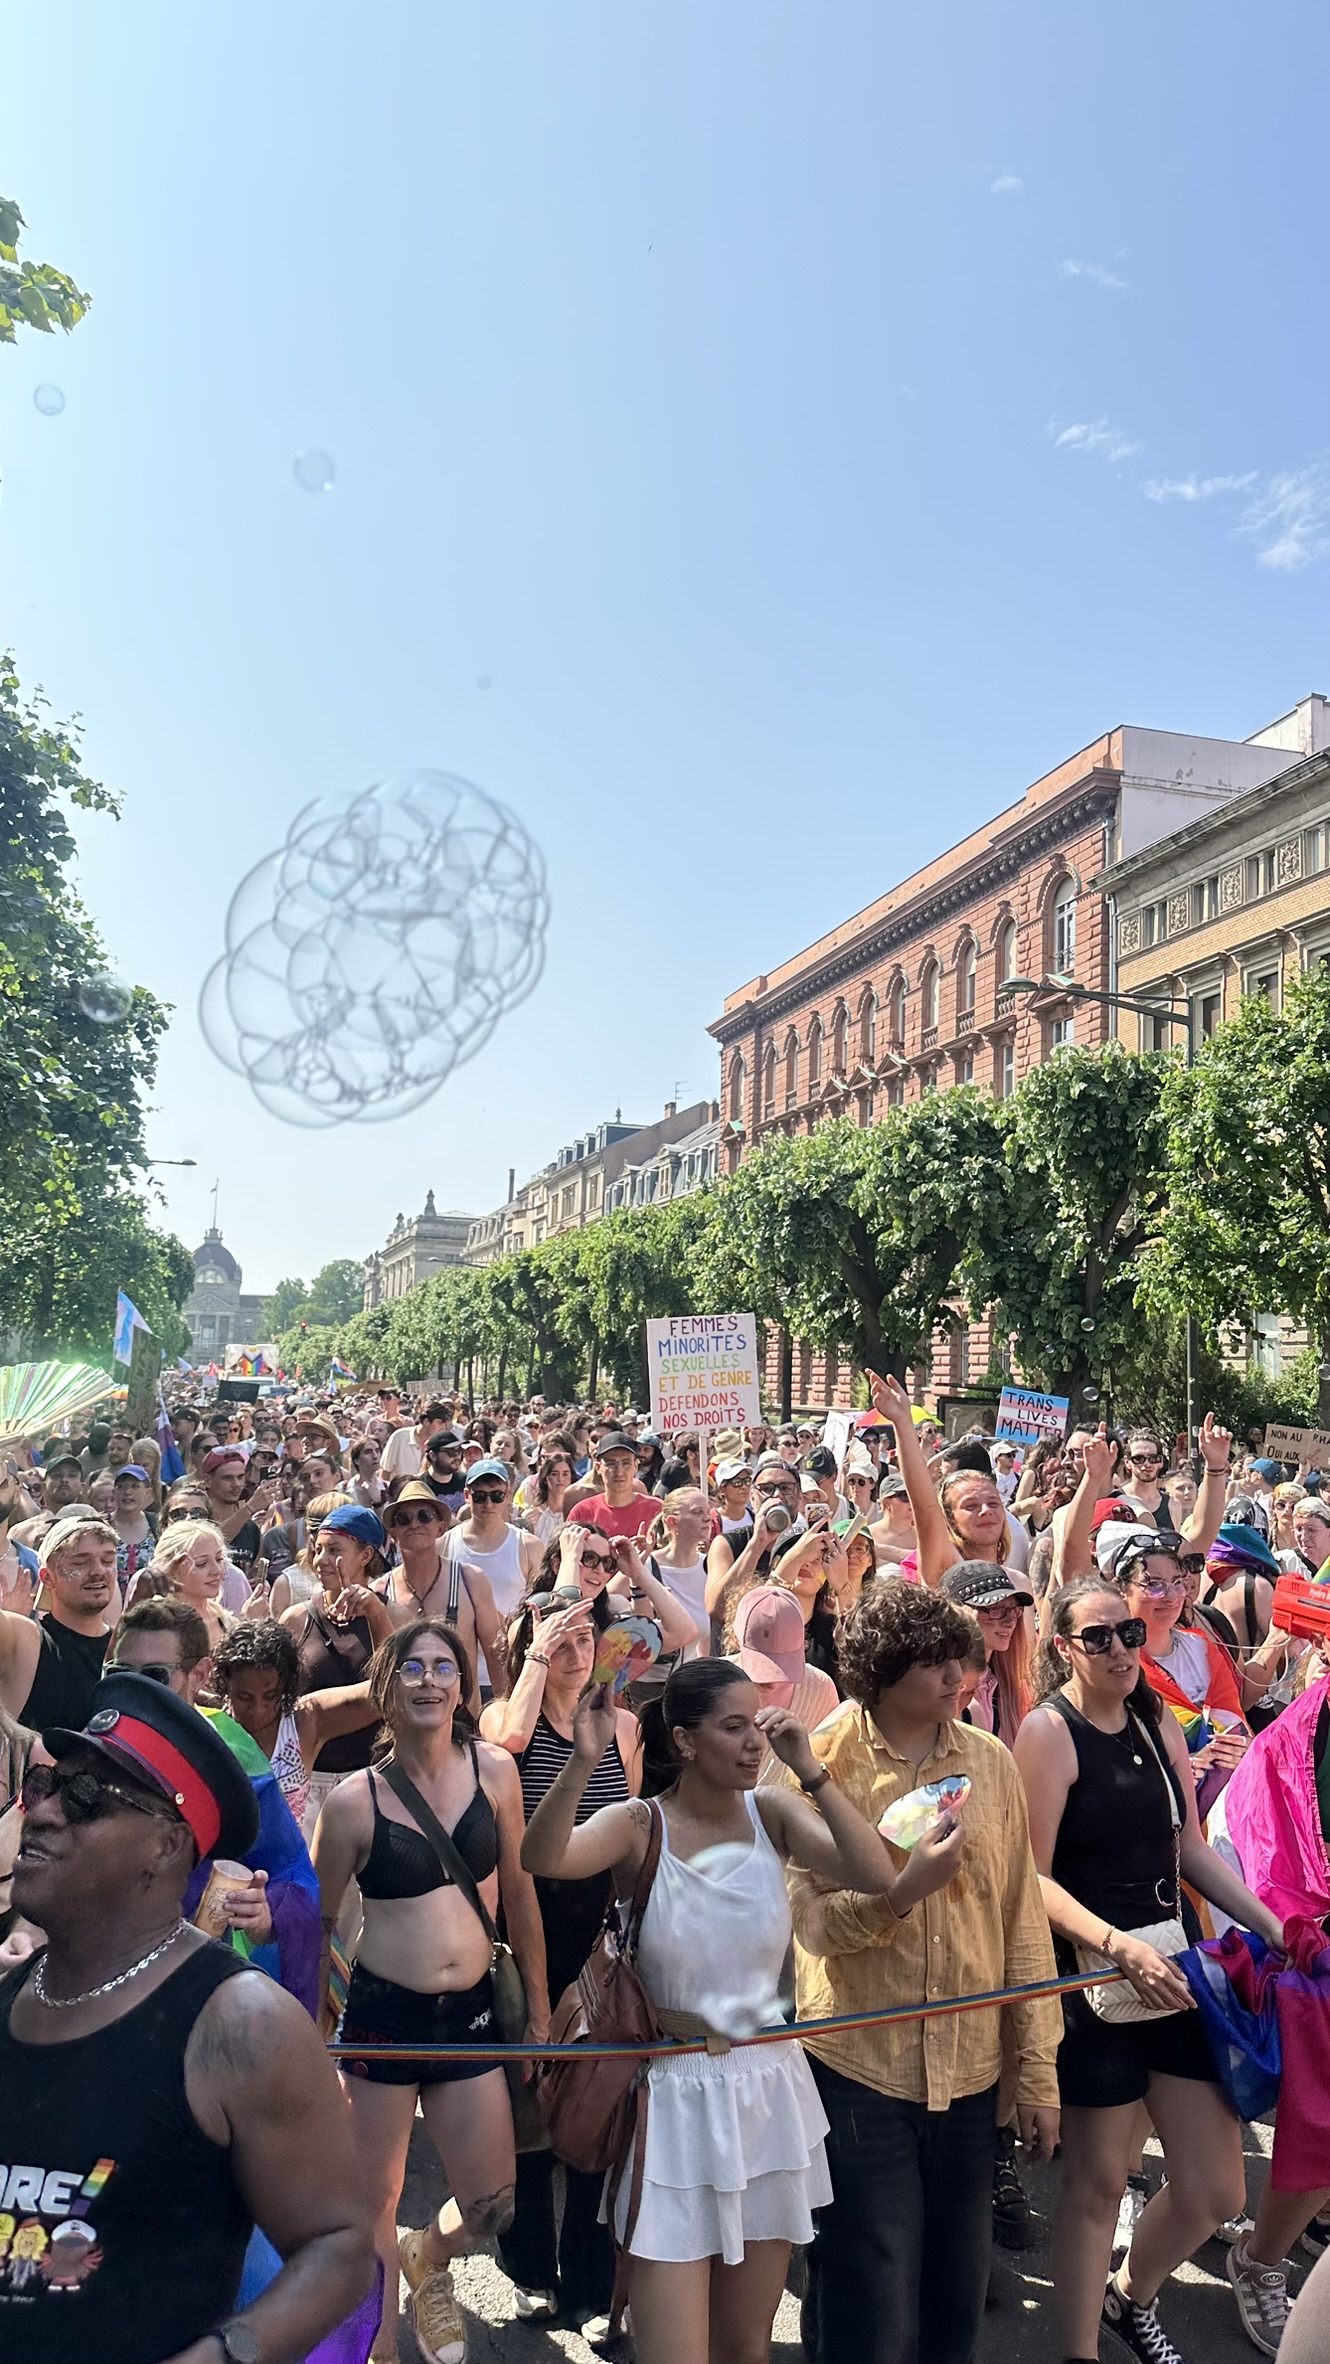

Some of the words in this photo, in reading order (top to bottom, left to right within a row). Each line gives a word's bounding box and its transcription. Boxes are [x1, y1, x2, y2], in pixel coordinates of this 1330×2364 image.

[669, 1315, 738, 1336] FEMMES
[661, 1353, 741, 1374] SEXUELLES
[659, 1376, 679, 1392] ET
[688, 1374, 706, 1389] DE
[711, 1371, 753, 1387] GENRE
[659, 1391, 739, 1413] DEFENDONS
[1006, 1391, 1054, 1412] TRANS
[663, 1413, 688, 1429] NOS
[1018, 1409, 1058, 1426] LIVES
[1270, 1429, 1288, 1440] NON
[1290, 1433, 1303, 1442] AU
[1284, 1451, 1300, 1461] AUX
[0, 2157, 116, 2217] RE!
